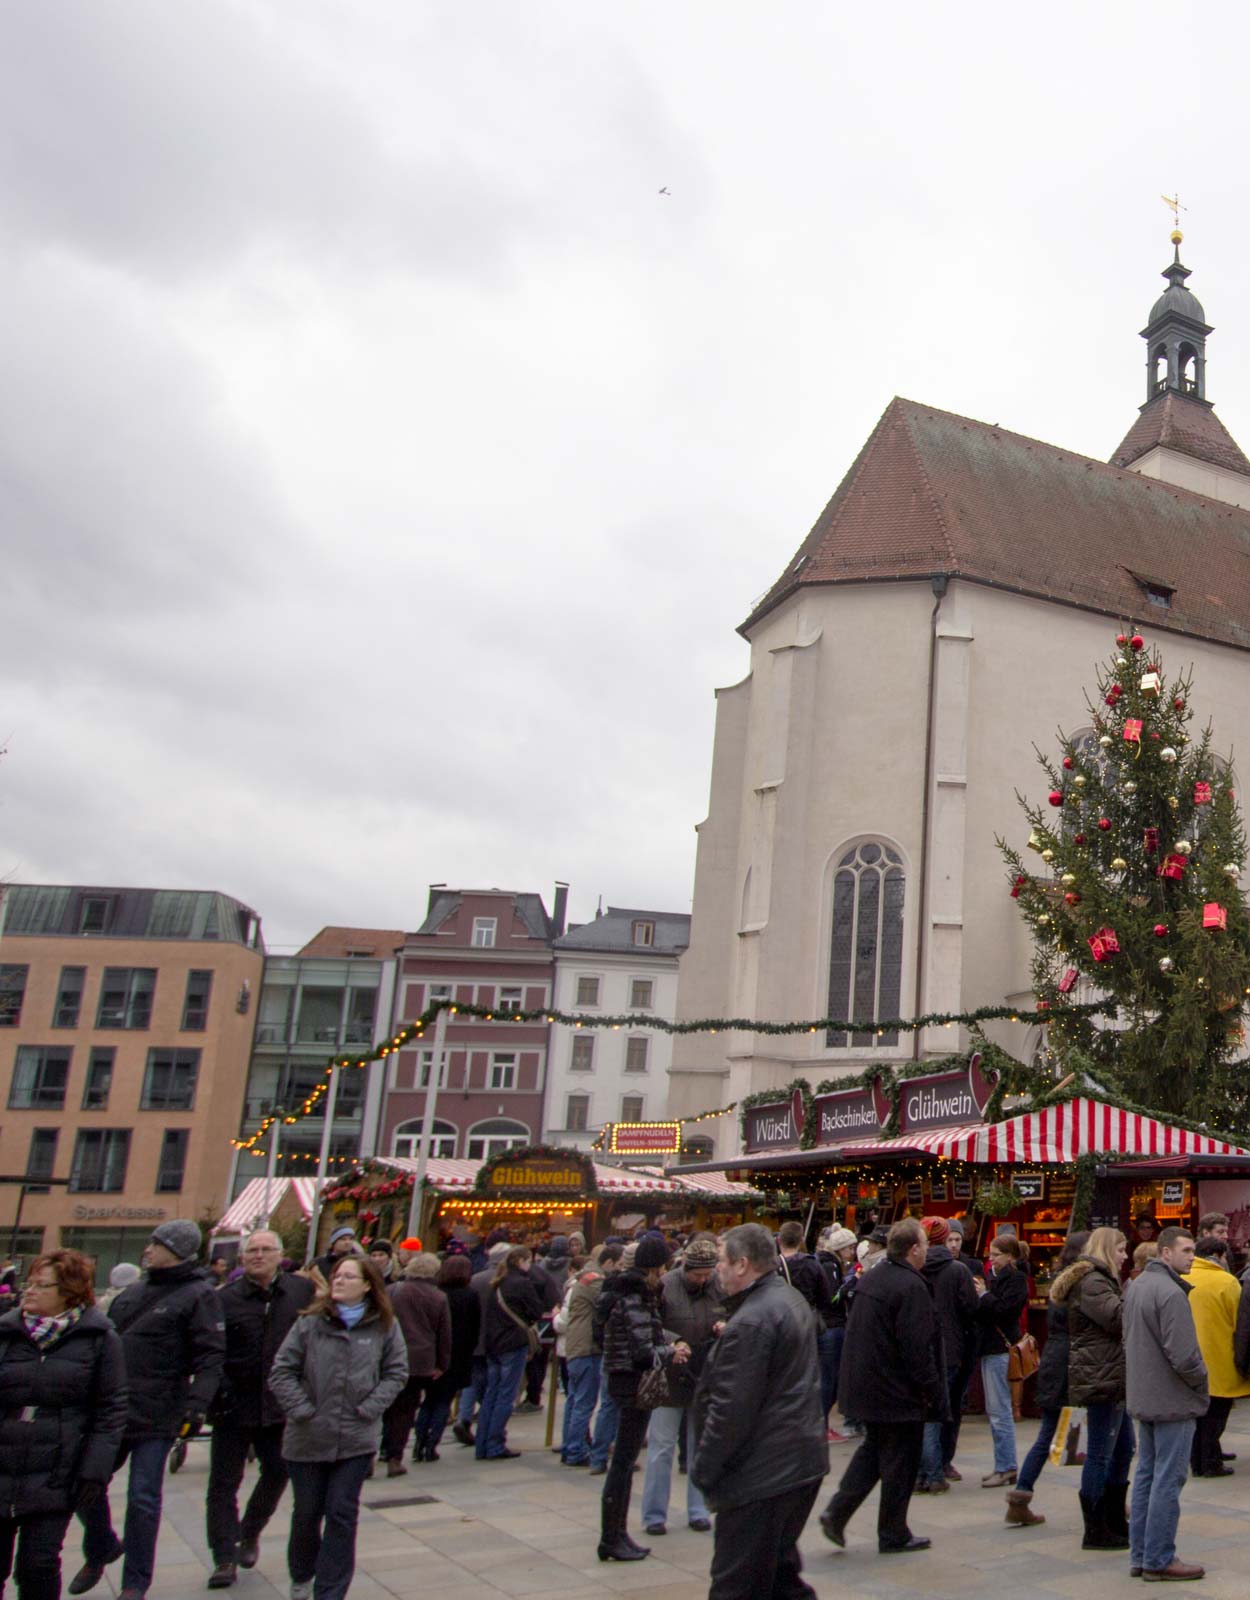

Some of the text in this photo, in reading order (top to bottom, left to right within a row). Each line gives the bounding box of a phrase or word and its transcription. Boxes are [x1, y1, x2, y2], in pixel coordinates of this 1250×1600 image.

[821, 1104, 877, 1133] Backschinken
[907, 1089, 972, 1123] Glühwein
[756, 1109, 791, 1143] Würstl
[492, 1167, 582, 1185] Glühwein
